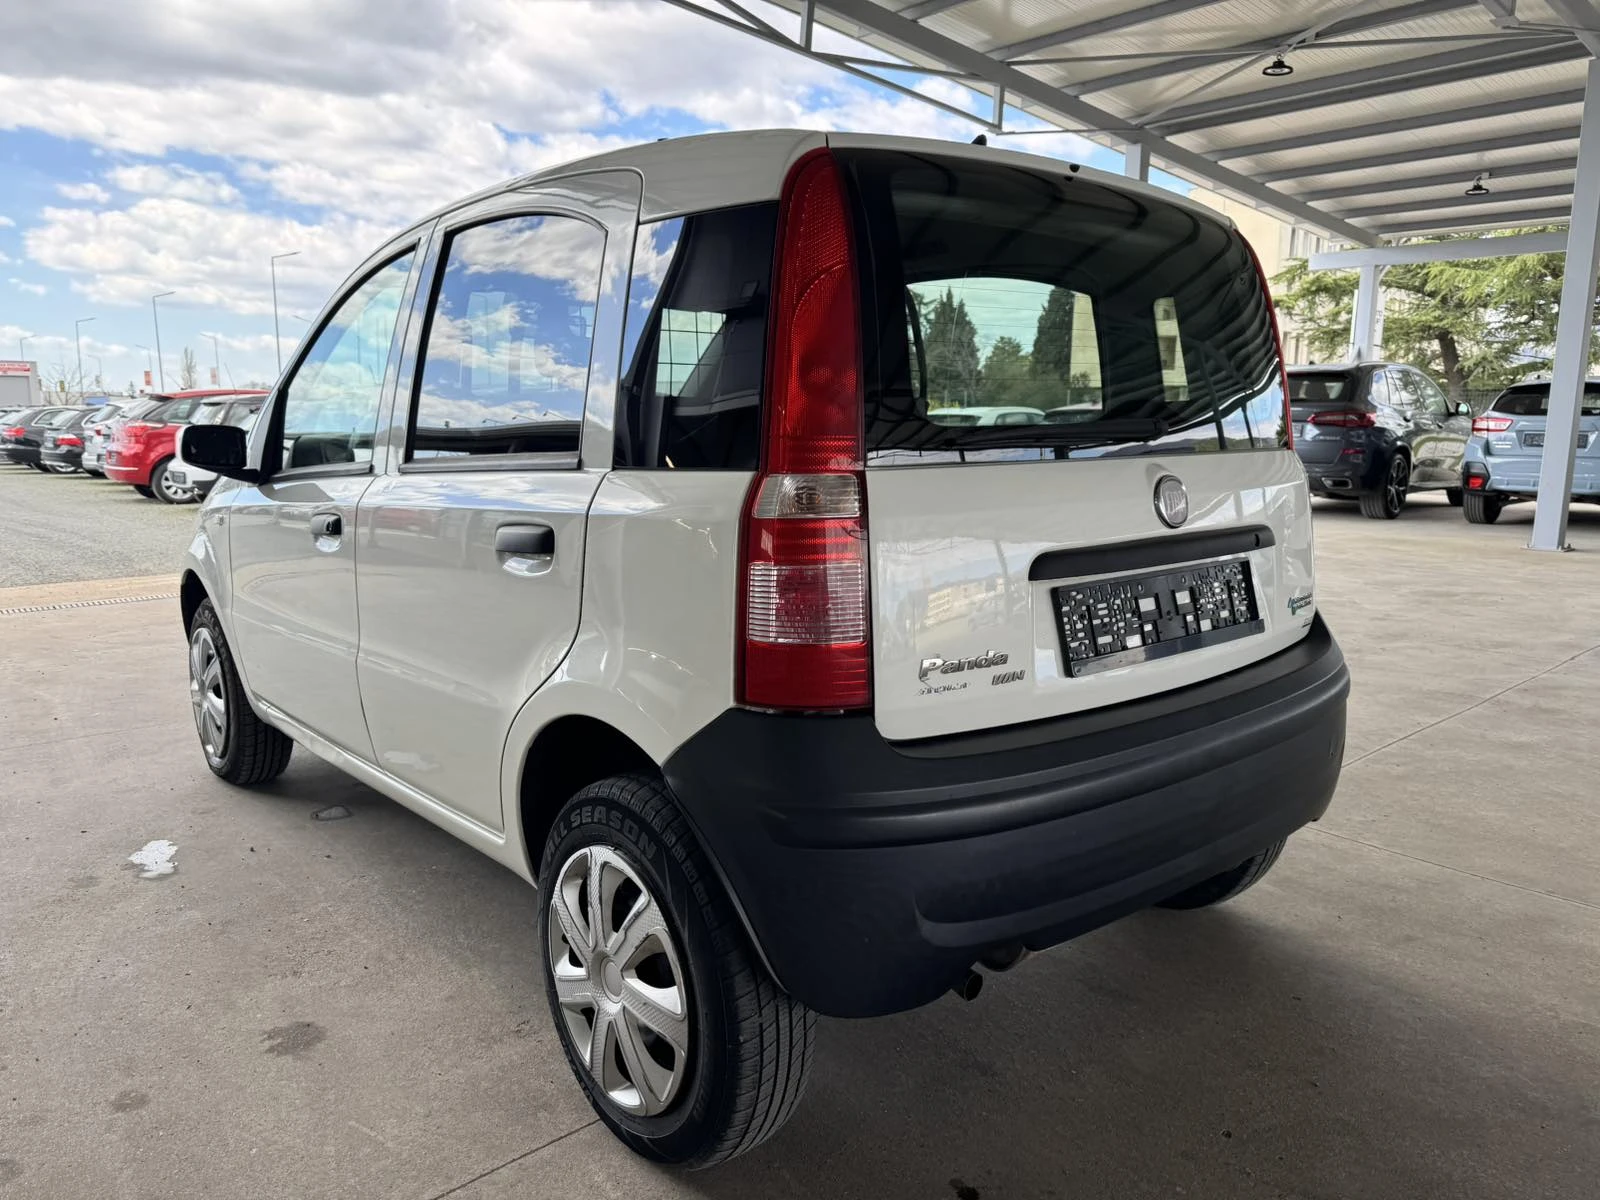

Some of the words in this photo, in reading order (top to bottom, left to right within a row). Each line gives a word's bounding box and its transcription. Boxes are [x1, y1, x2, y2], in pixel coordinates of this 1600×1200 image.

[919, 650, 1008, 680] Panda
[992, 670, 1025, 685] VAN
[547, 822, 568, 862] ALL
[570, 805, 657, 859] SEASON
